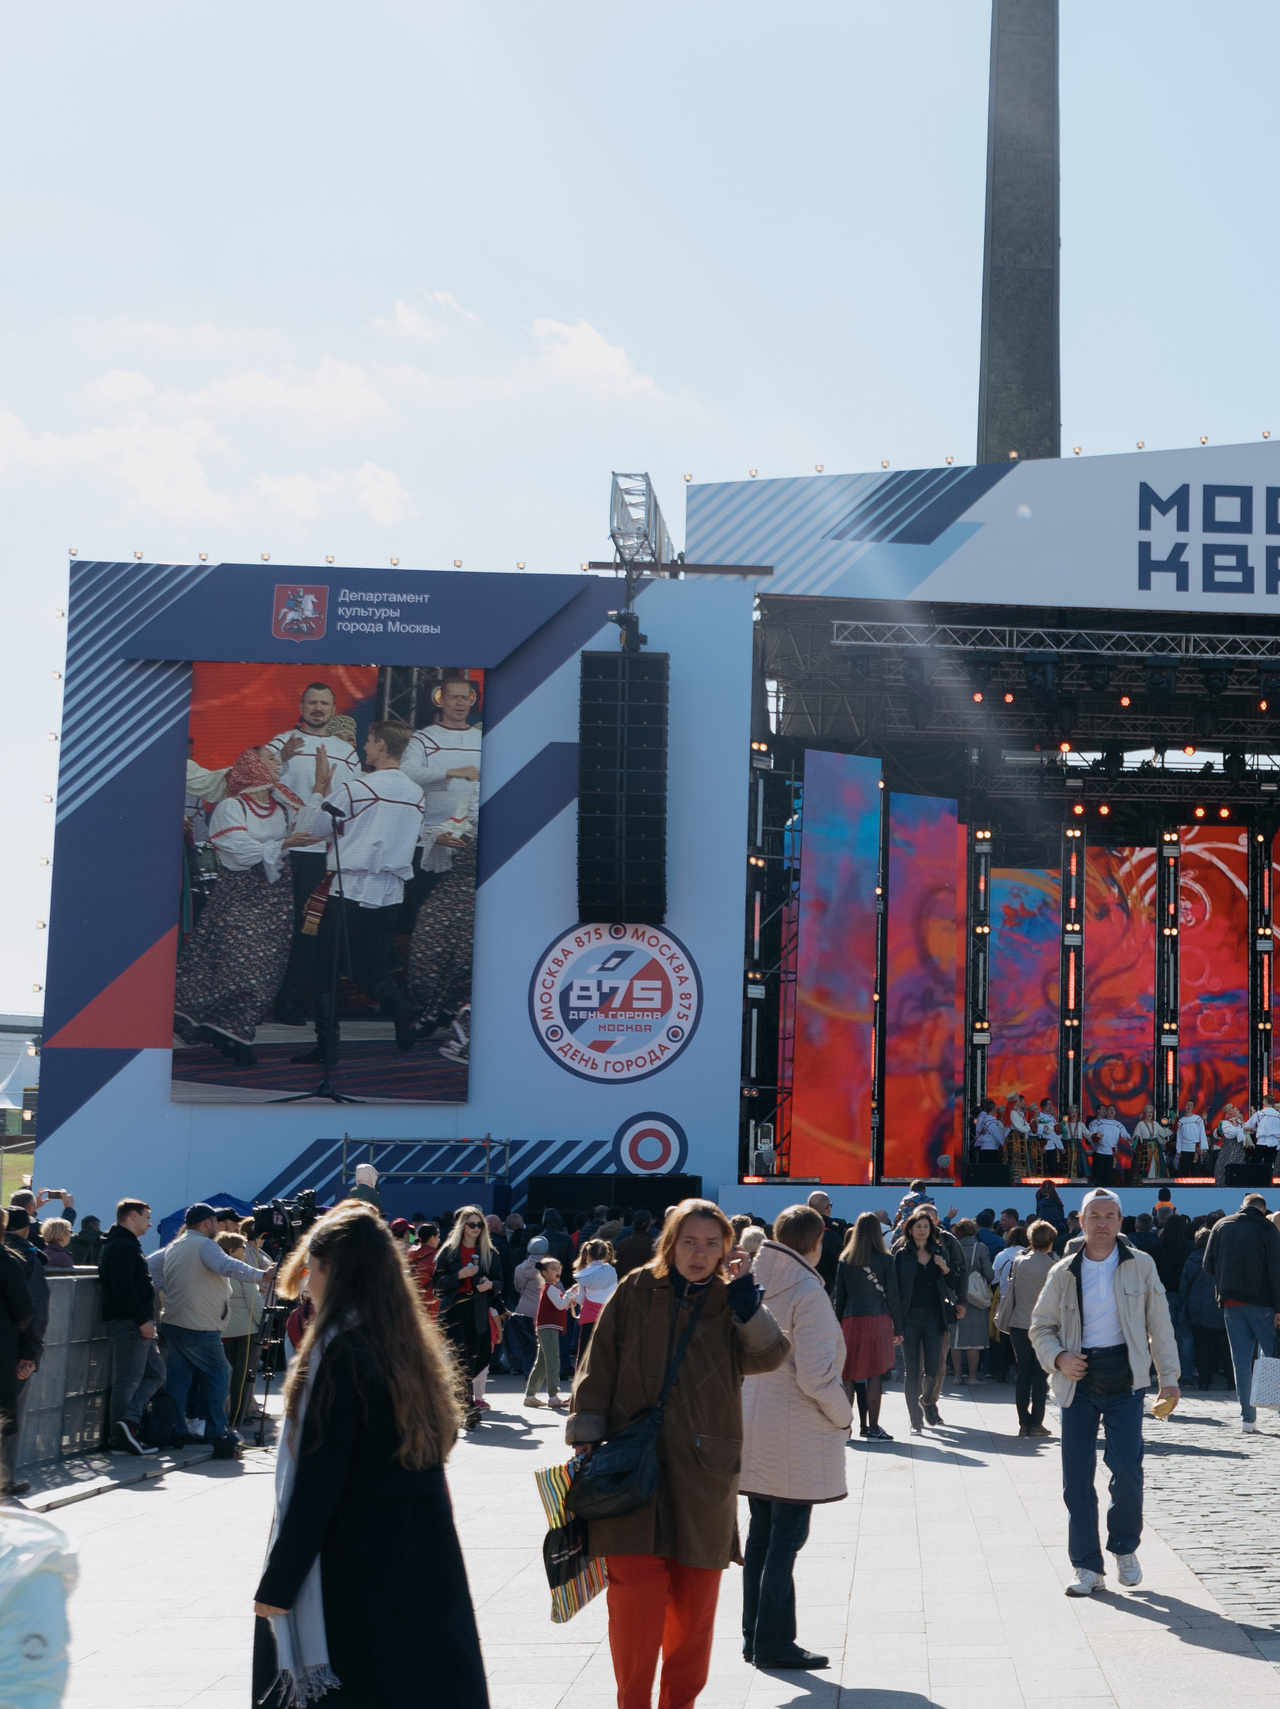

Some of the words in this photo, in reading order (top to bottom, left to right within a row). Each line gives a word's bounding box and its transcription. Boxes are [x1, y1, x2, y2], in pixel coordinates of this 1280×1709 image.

[338, 588, 430, 604] Департамент
[337, 606, 400, 619] культуры
[336, 622, 384, 634] города
[387, 621, 441, 634] Москвы
[539, 948, 574, 1021] МОСКВА
[574, 927, 603, 948] 875
[631, 927, 690, 987] МОСКВА
[676, 992, 692, 1022] 875
[569, 979, 663, 1009] 875
[568, 1011, 605, 1020] ДЕНЬ
[608, 1011, 662, 1020] ГОРОДА
[598, 1024, 652, 1032] МОСКВА
[557, 1042, 599, 1071] ДЕНЬ
[604, 1043, 670, 1073] ГОРОДА
